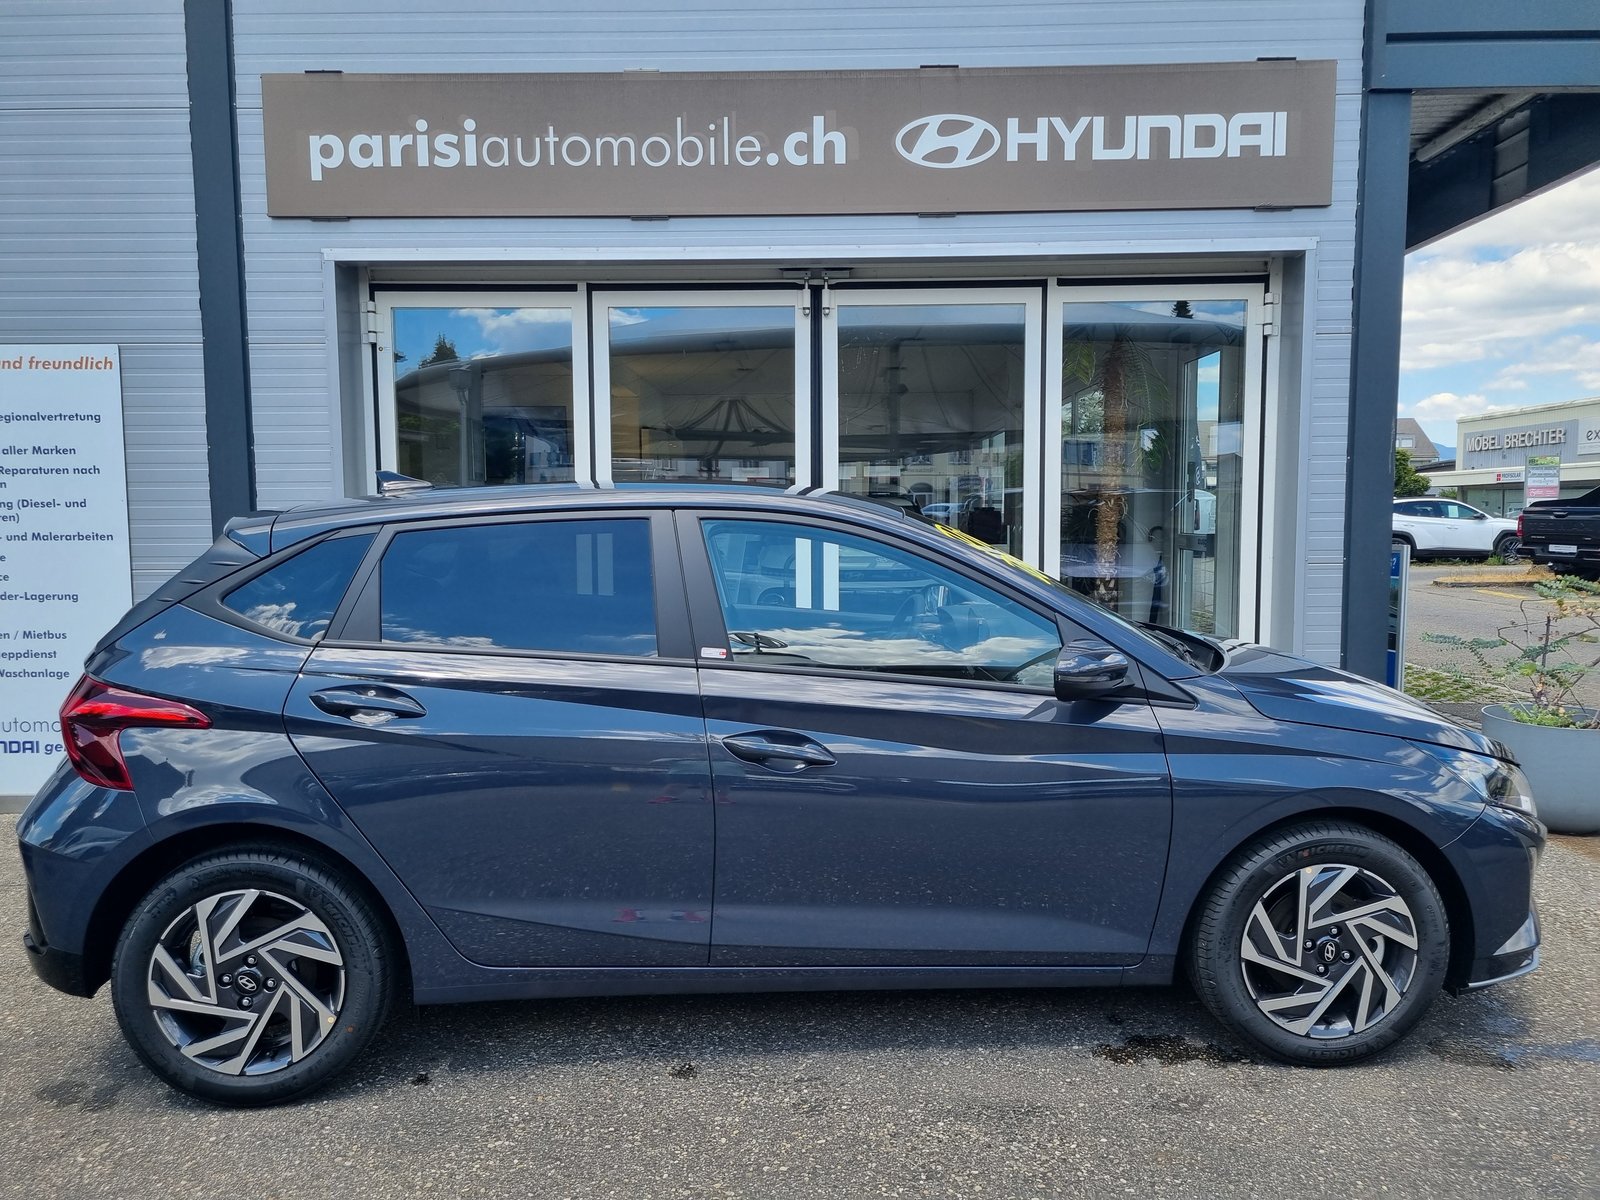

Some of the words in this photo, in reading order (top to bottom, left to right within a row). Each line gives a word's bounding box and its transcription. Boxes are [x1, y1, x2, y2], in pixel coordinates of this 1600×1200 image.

[1006, 111, 1288, 162] HYUNDAI
[308, 115, 847, 181] parisiautomobile.ch
[0, 356, 23, 370] nd
[28, 356, 114, 370] freundlich
[1504, 427, 1567, 448] BRECHTER
[2, 445, 29, 455] aller
[32, 446, 77, 455] Marken
[73, 465, 101, 475] nach
[17, 499, 61, 511] (Diesel-
[65, 498, 87, 508] und
[6, 531, 28, 541] und
[31, 531, 114, 541] Malerarbeiten
[0, 591, 79, 603] der-Lagerung
[22, 630, 67, 640] Mietbus
[1, 649, 57, 661] eppdienst
